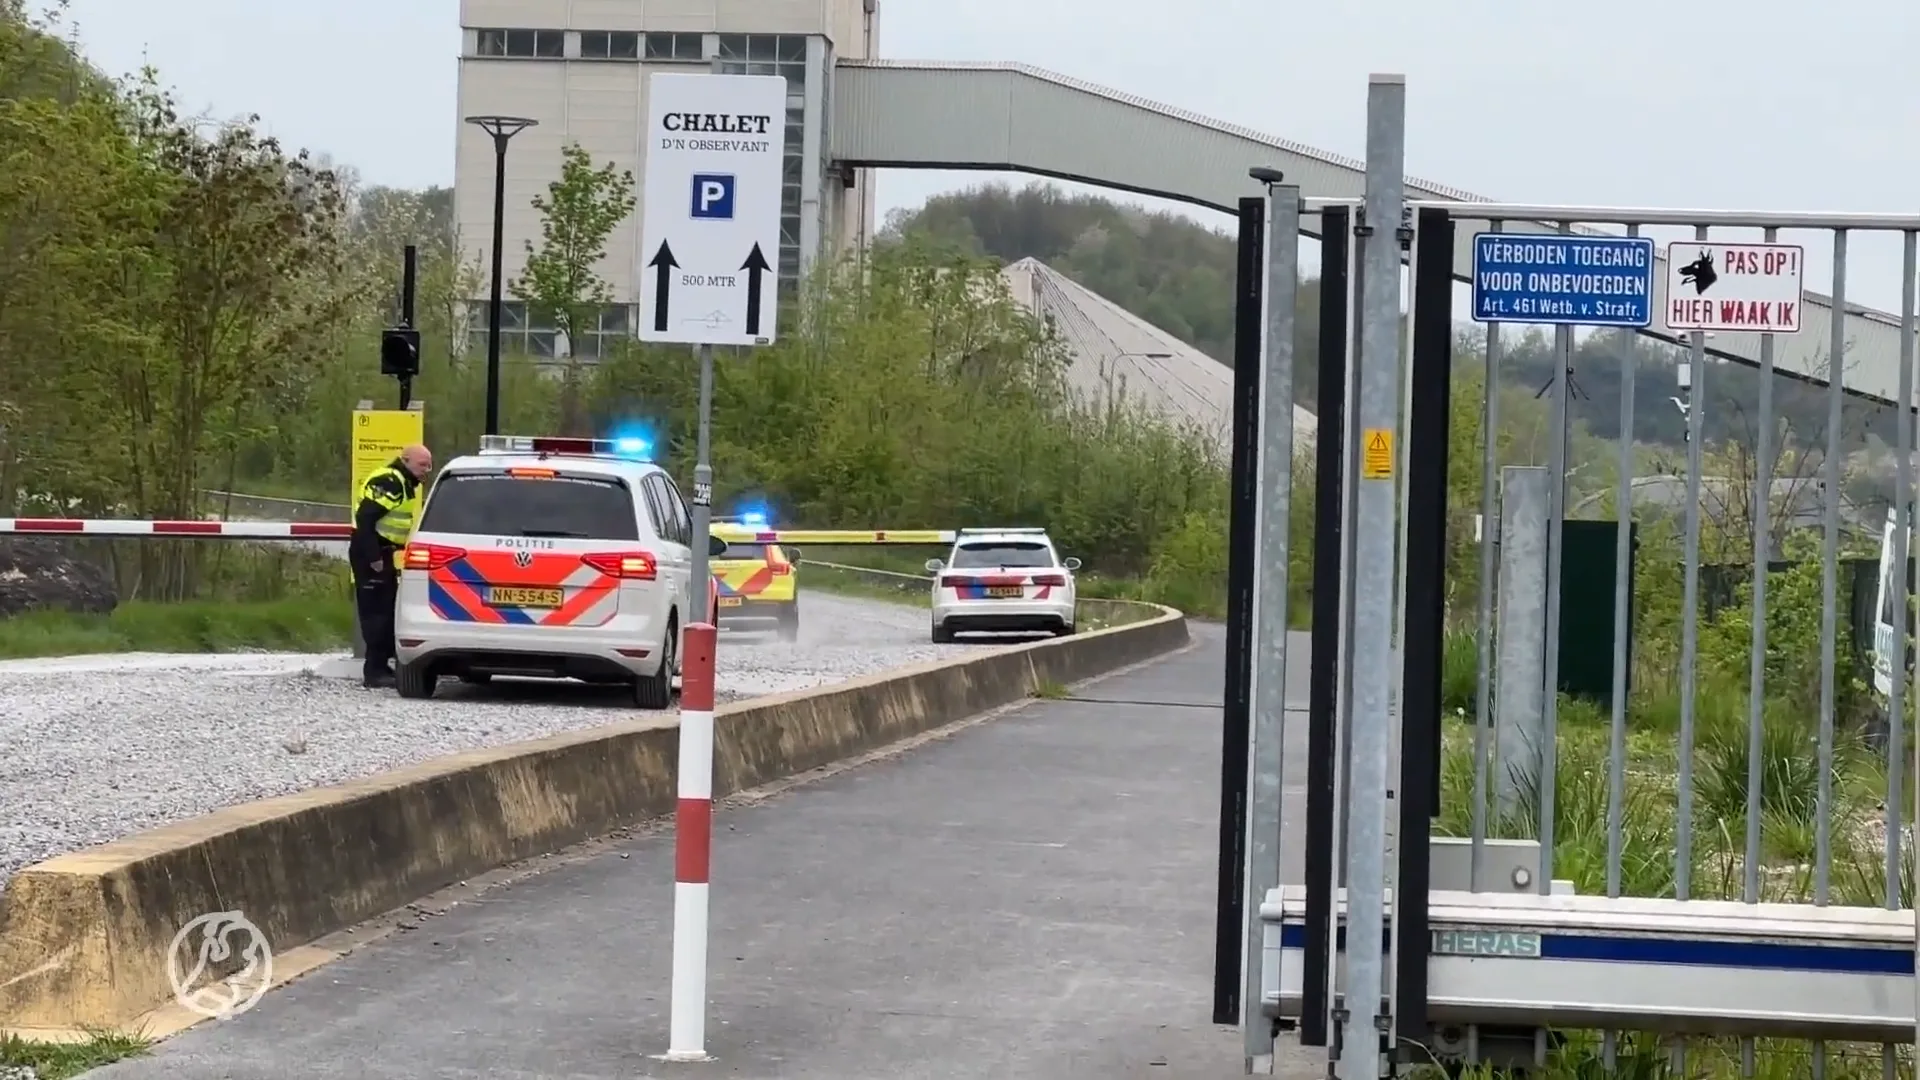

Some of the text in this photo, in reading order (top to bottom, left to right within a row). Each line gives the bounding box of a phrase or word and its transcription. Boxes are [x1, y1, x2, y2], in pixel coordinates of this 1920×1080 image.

[662, 112, 771, 134] CHALET
[661, 138, 770, 153] D'N OBSERVANT
[700, 180, 725, 212] P
[1482, 242, 1645, 267] VERBODEN TOEGANG
[1725, 250, 1759, 275] PAS
[681, 275, 737, 288] 500 MTR
[1480, 271, 1646, 296] VOOR ONBEVOEGDEN
[1482, 296, 1641, 318] Art. 461 Wetb. v. Strafr.
[1672, 299, 1795, 326] HIER WAAK IK
[496, 538, 556, 550] POLITIE
[493, 588, 560, 604] NN-554-S
[1436, 930, 1538, 955] HERAS
